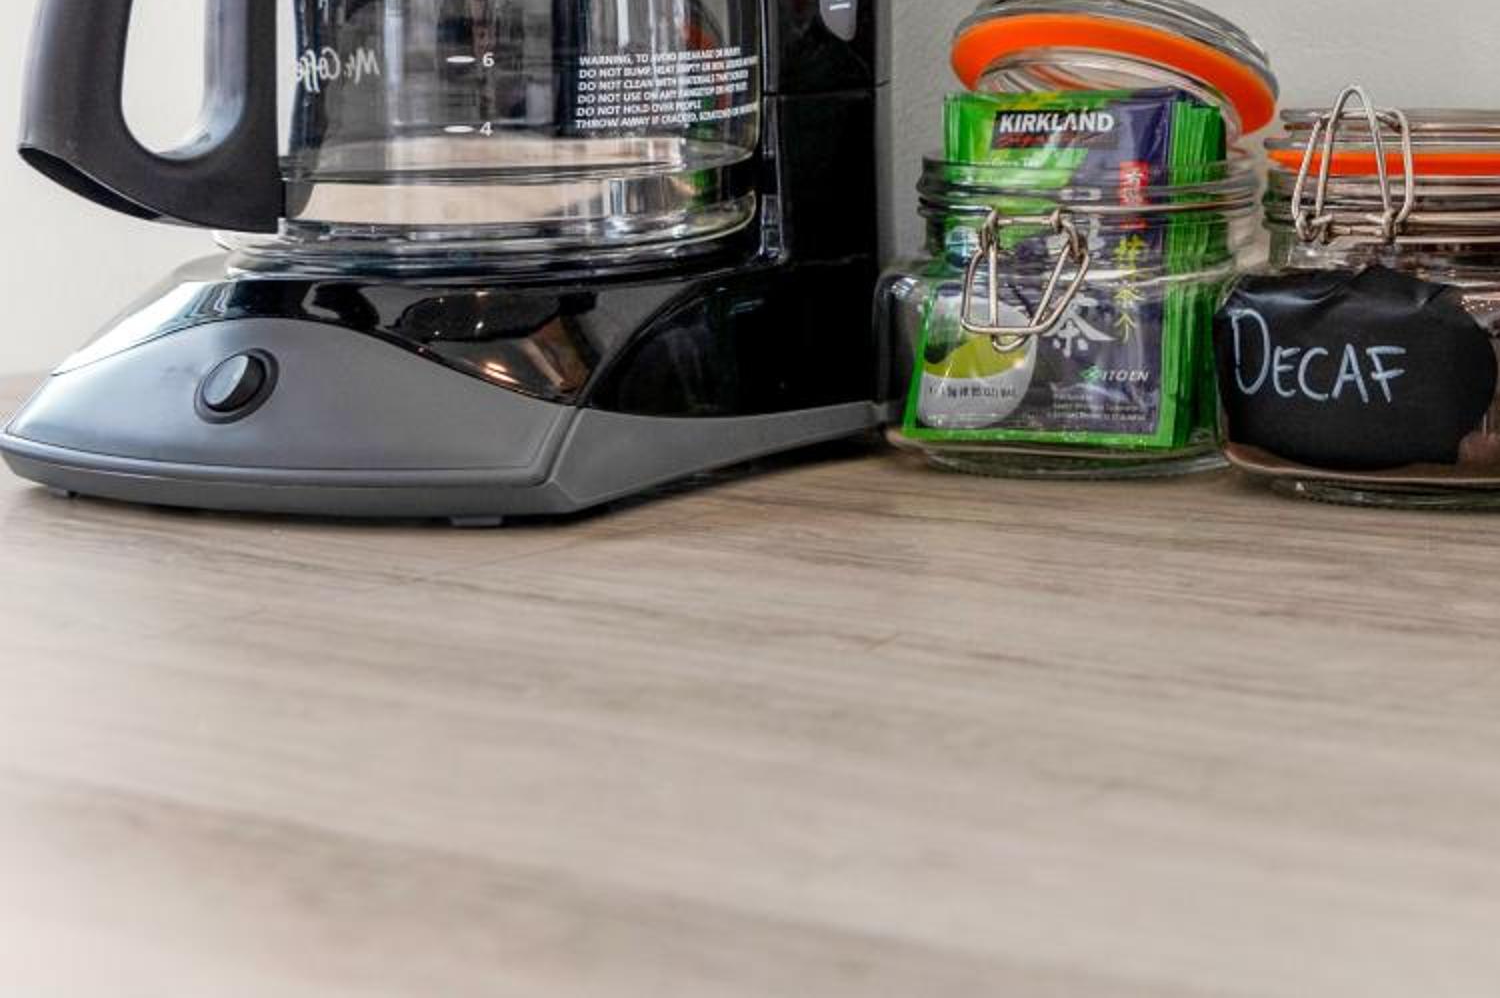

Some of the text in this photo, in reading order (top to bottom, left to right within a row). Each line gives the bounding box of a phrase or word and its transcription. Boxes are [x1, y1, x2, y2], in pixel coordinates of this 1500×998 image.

[482, 52, 495, 67] 6
[636, 54, 648, 64] TO
[652, 53, 676, 63] AVOID
[579, 68, 596, 80] DO
[600, 67, 621, 78] NOT
[578, 81, 596, 92] DO
[600, 80, 621, 91] NOT
[623, 79, 652, 89] CLEAN
[655, 76, 677, 87] WITH
[577, 94, 595, 104] DO
[599, 93, 621, 103] NOT
[623, 91, 641, 101] USE
[644, 90, 656, 100] ON
[577, 106, 595, 117] DO
[597, 105, 621, 116] NOT
[623, 104, 650, 114] HOLD
[652, 102, 674, 113] OVER
[479, 122, 493, 136] 4
[575, 118, 619, 129] THROW
[620, 116, 650, 128] AWAY
[651, 115, 660, 126] IF
[999, 111, 1115, 133] KIRKLAND
[1227, 308, 1406, 404] DECAF
